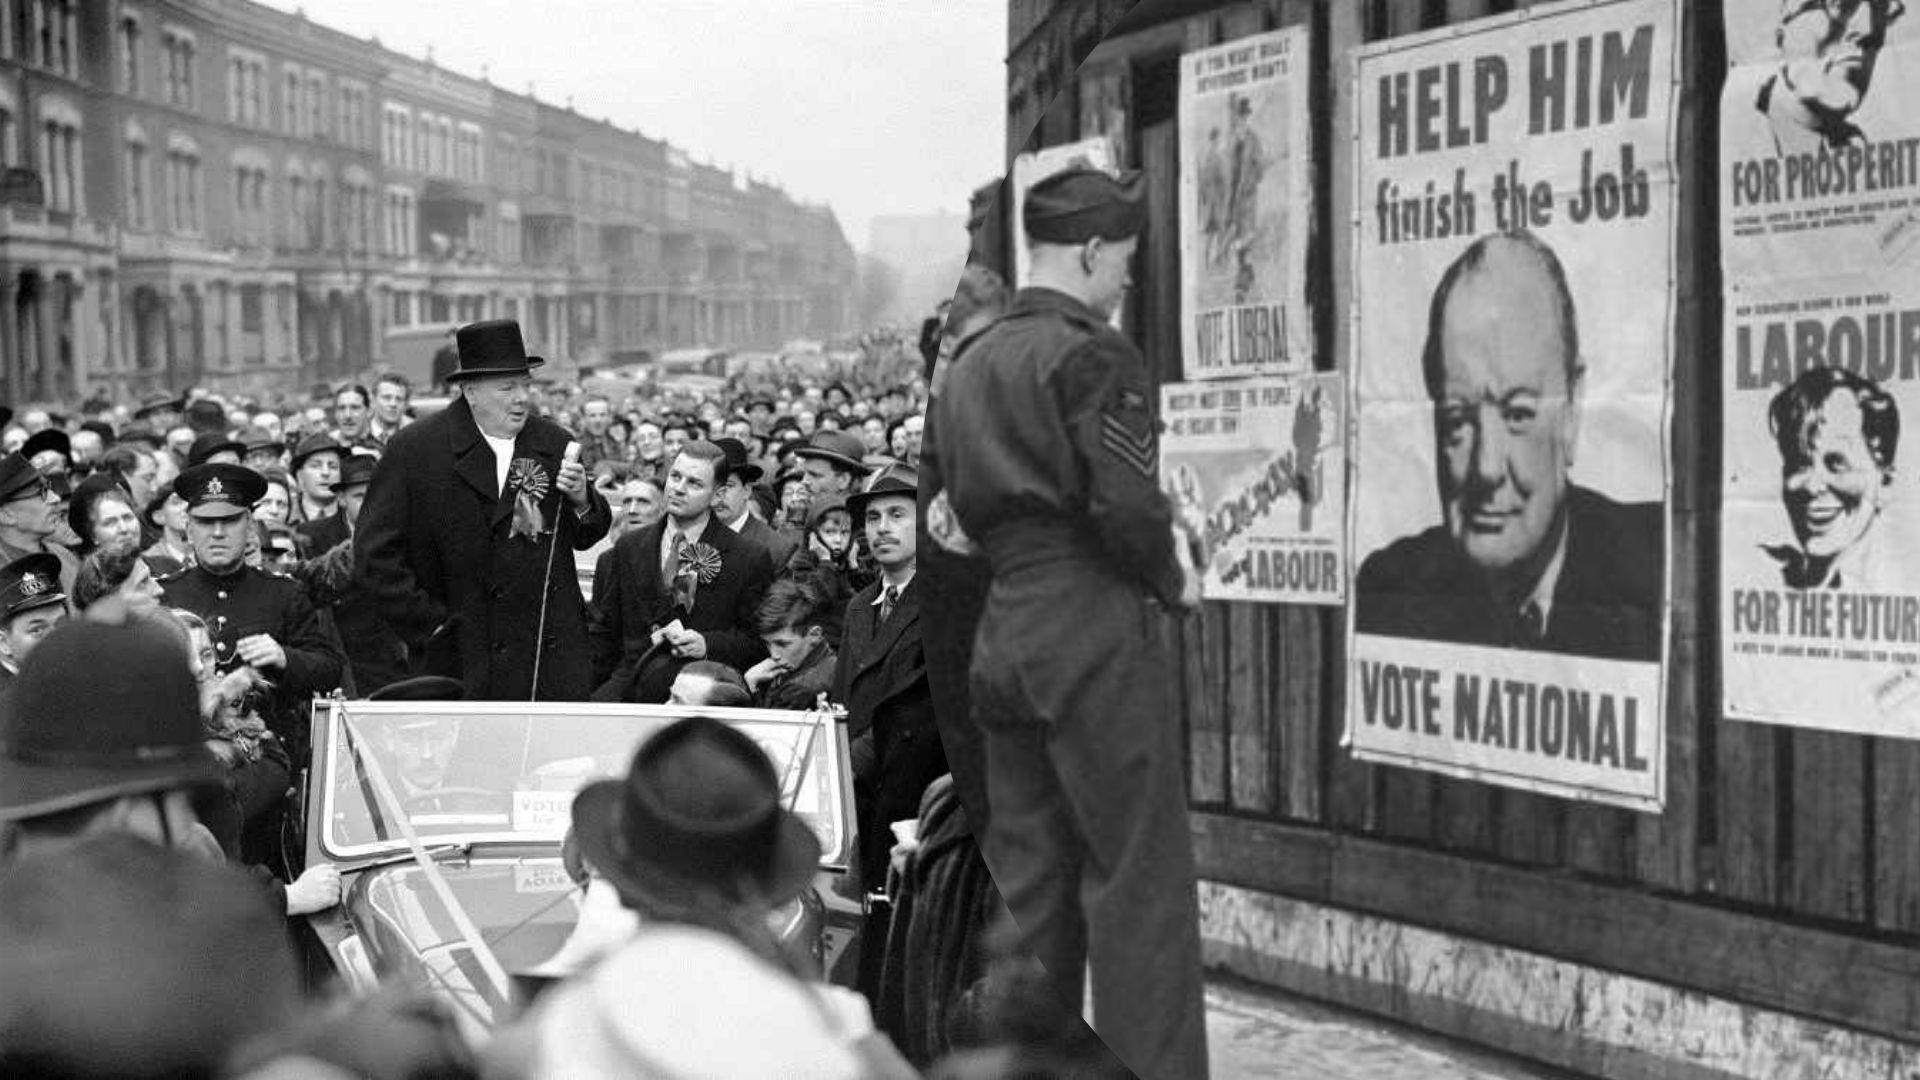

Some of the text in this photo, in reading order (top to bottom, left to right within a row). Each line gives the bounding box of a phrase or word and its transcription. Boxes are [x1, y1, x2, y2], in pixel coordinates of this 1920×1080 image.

[1377, 23, 1655, 159] HELP HIM
[1376, 168, 1476, 244] finish
[1492, 159, 1553, 233] the
[1568, 142, 1650, 224] Job
[1733, 157, 1780, 206] FOR
[1194, 310, 1224, 369] VOTE
[1246, 549, 1338, 592] LABOUR
[1733, 590, 1780, 634] FOR
[1785, 592, 1832, 638] THE
[1360, 660, 1648, 772] VOTE NATIONAL
